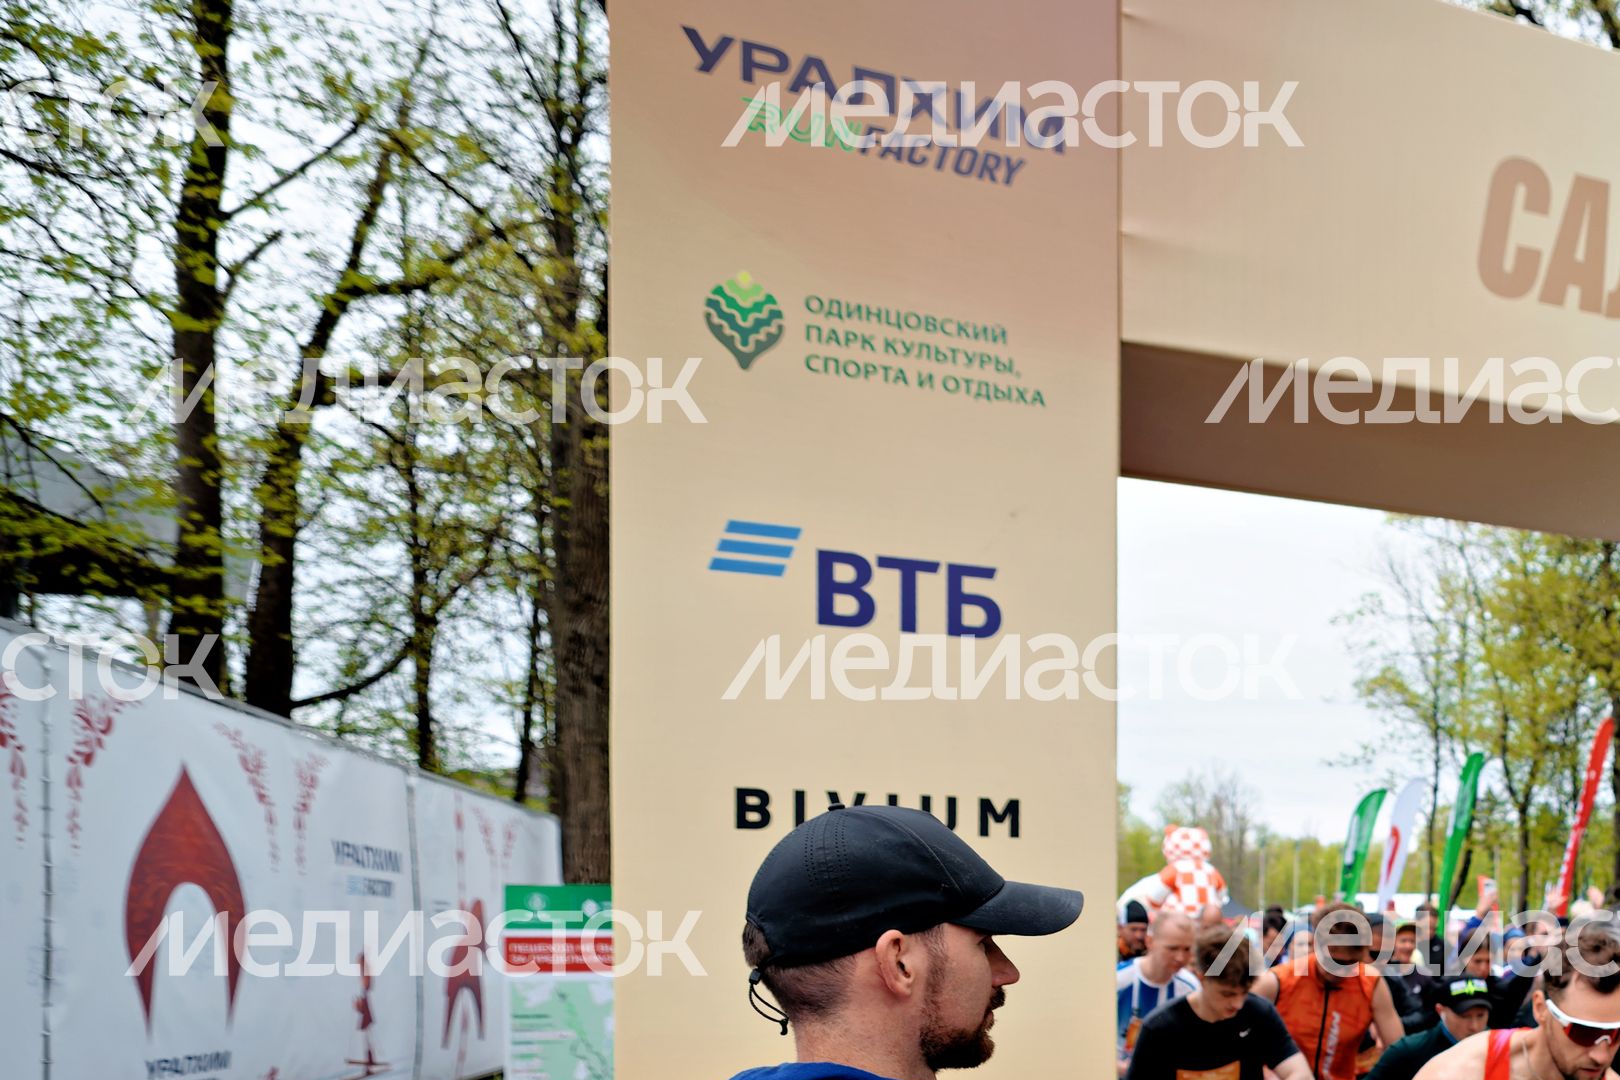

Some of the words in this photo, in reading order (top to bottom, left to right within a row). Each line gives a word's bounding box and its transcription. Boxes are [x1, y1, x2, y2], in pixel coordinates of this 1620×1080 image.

[680, 24, 1068, 154] УРАЛХИМ
[804, 294, 1008, 345] ОДИНЦОВСКИЙ
[804, 323, 877, 352] ПАРК
[883, 337, 1021, 377] КУЛЬТУРЫ,
[804, 354, 909, 387] СПОРТА
[916, 371, 935, 390] И
[941, 374, 1047, 407] ОТДЫХА
[816, 547, 1002, 640] ВТБ
